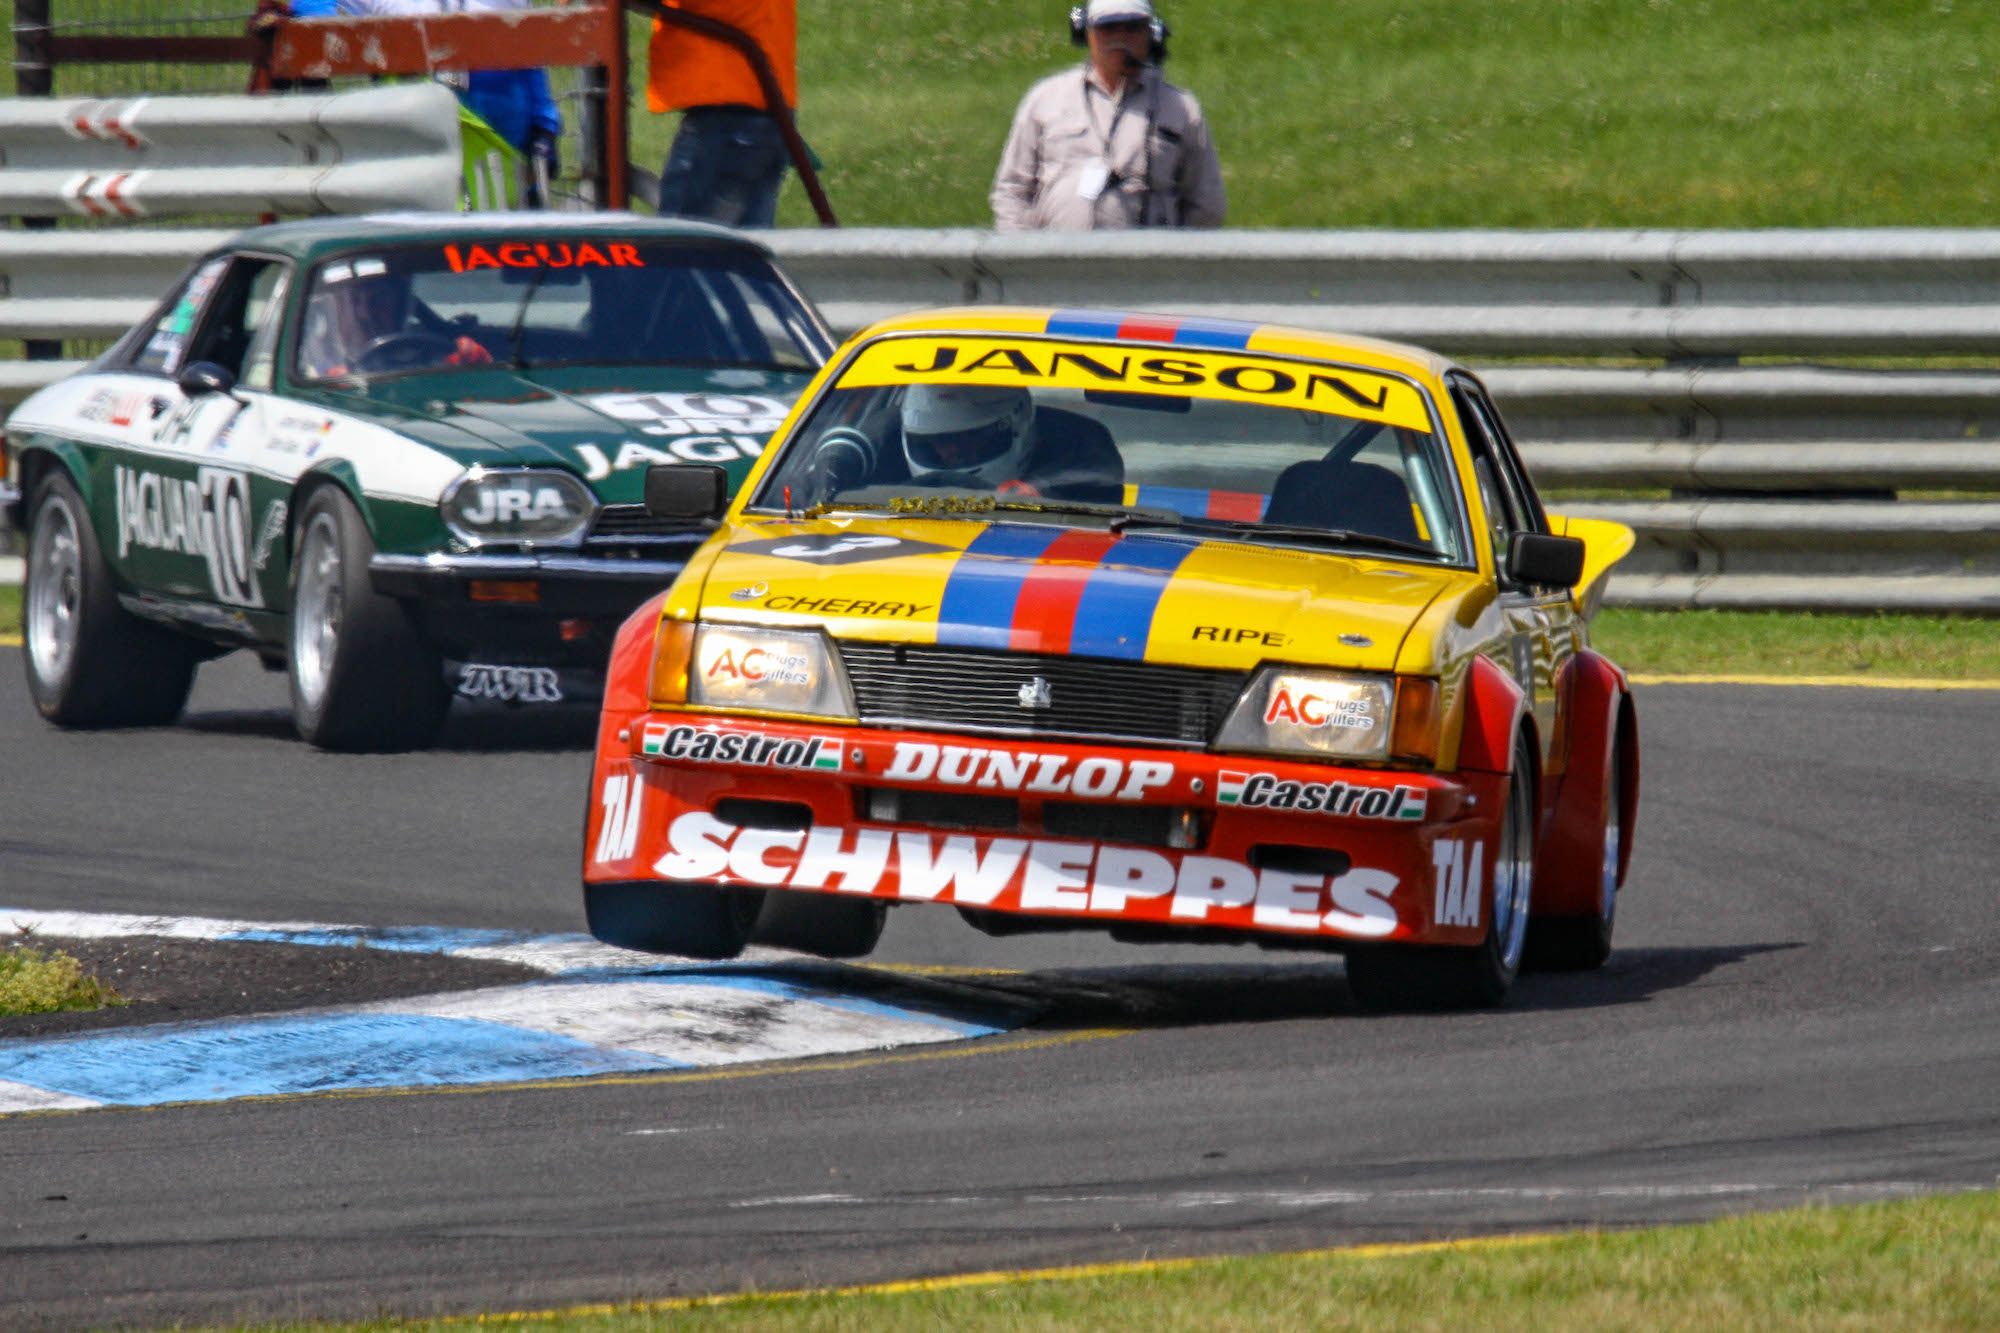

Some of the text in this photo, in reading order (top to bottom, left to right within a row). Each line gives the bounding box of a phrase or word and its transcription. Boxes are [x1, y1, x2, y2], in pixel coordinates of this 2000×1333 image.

[444, 242, 646, 274] JAGUAR
[893, 346, 1391, 412] JANSON
[461, 487, 572, 525] JRA
[198, 466, 266, 609] 10
[764, 595, 935, 617] CHERRY
[1191, 626, 1286, 648] RIPE
[708, 648, 766, 680] AC
[767, 652, 806, 667] ugs
[1266, 689, 1325, 726] AC
[1329, 699, 1367, 713] lugs
[661, 725, 823, 769] Castrol
[883, 742, 1175, 800] DUNLOP
[1240, 773, 1408, 819] Castrol
[595, 774, 644, 863] TAA
[653, 811, 1400, 937] SCHWEPPES
[1432, 838, 1484, 928] TAA
